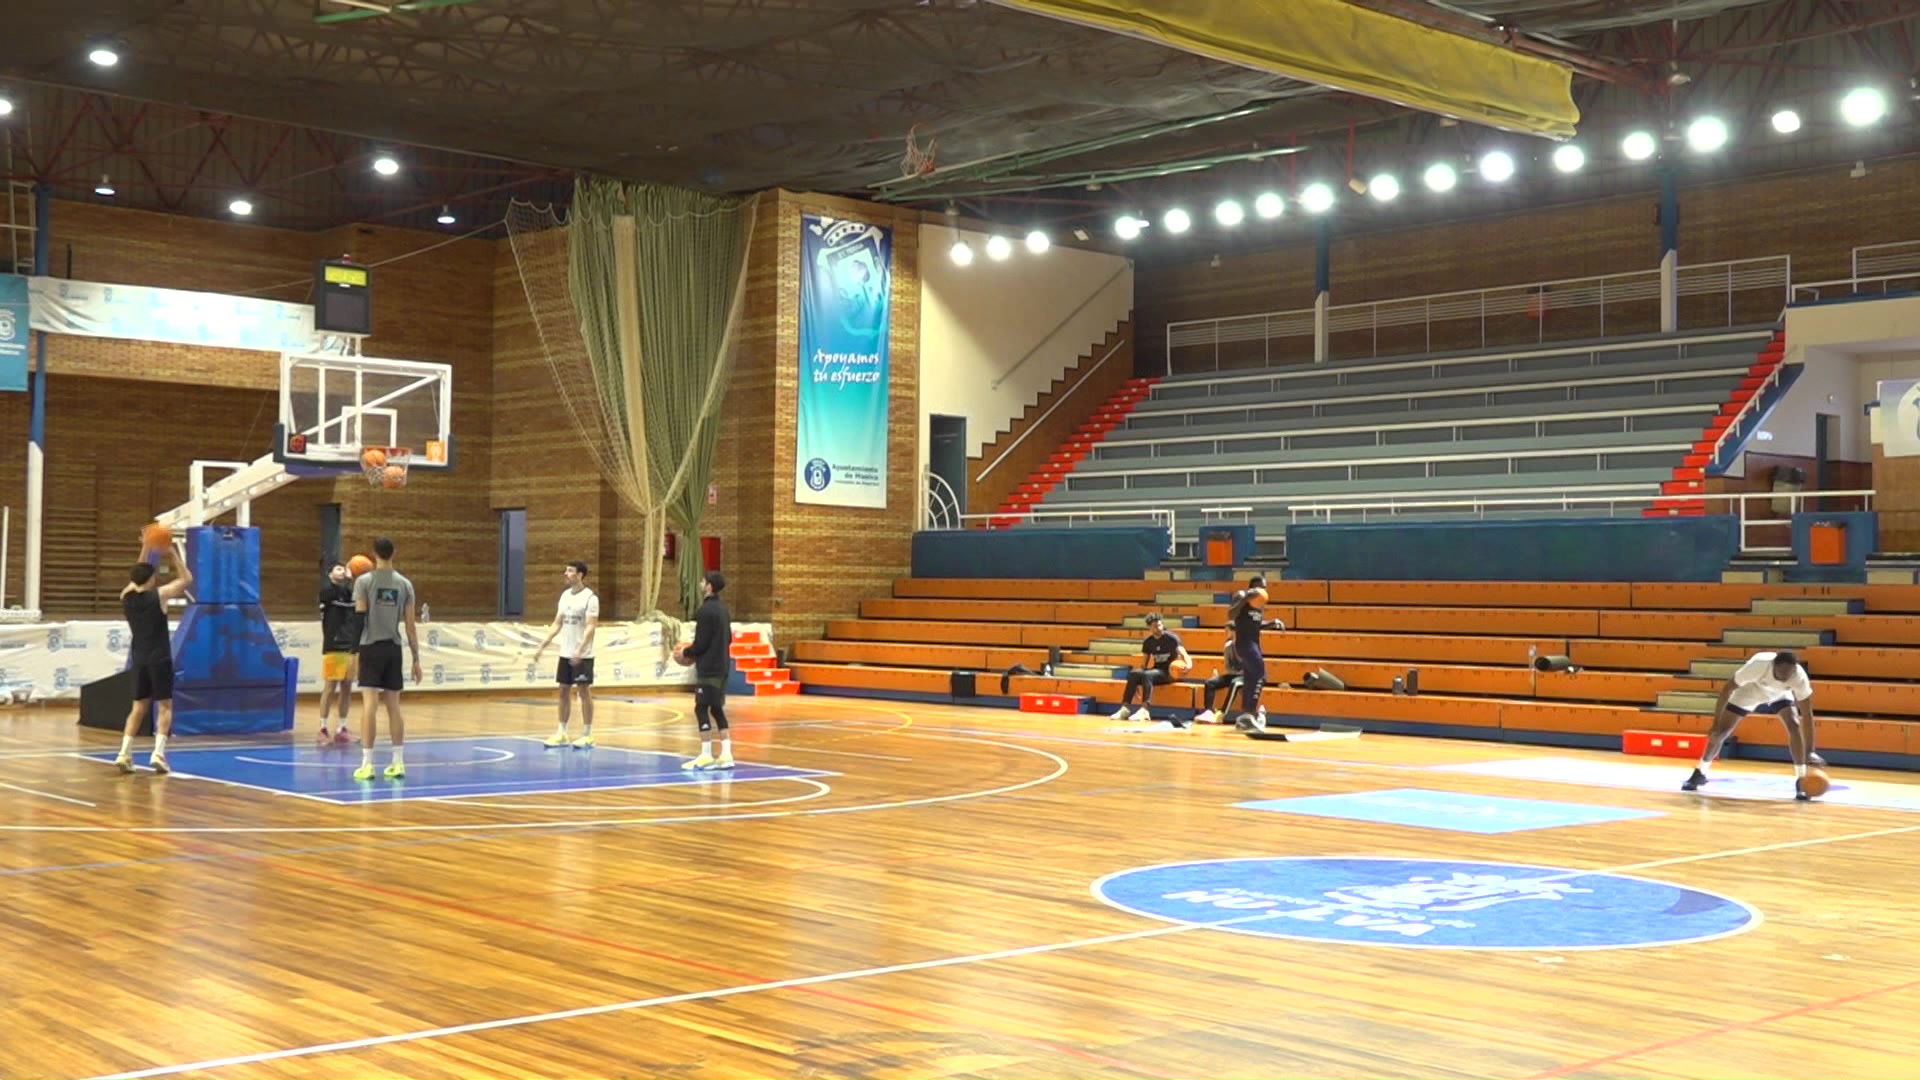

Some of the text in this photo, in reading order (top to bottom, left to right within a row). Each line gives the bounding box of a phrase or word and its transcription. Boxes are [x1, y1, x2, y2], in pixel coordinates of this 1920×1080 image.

[813, 348, 879, 372] Apoyamos
[813, 366, 880, 391] tu esfuerzo
[1160, 890, 1436, 937] HULVA
